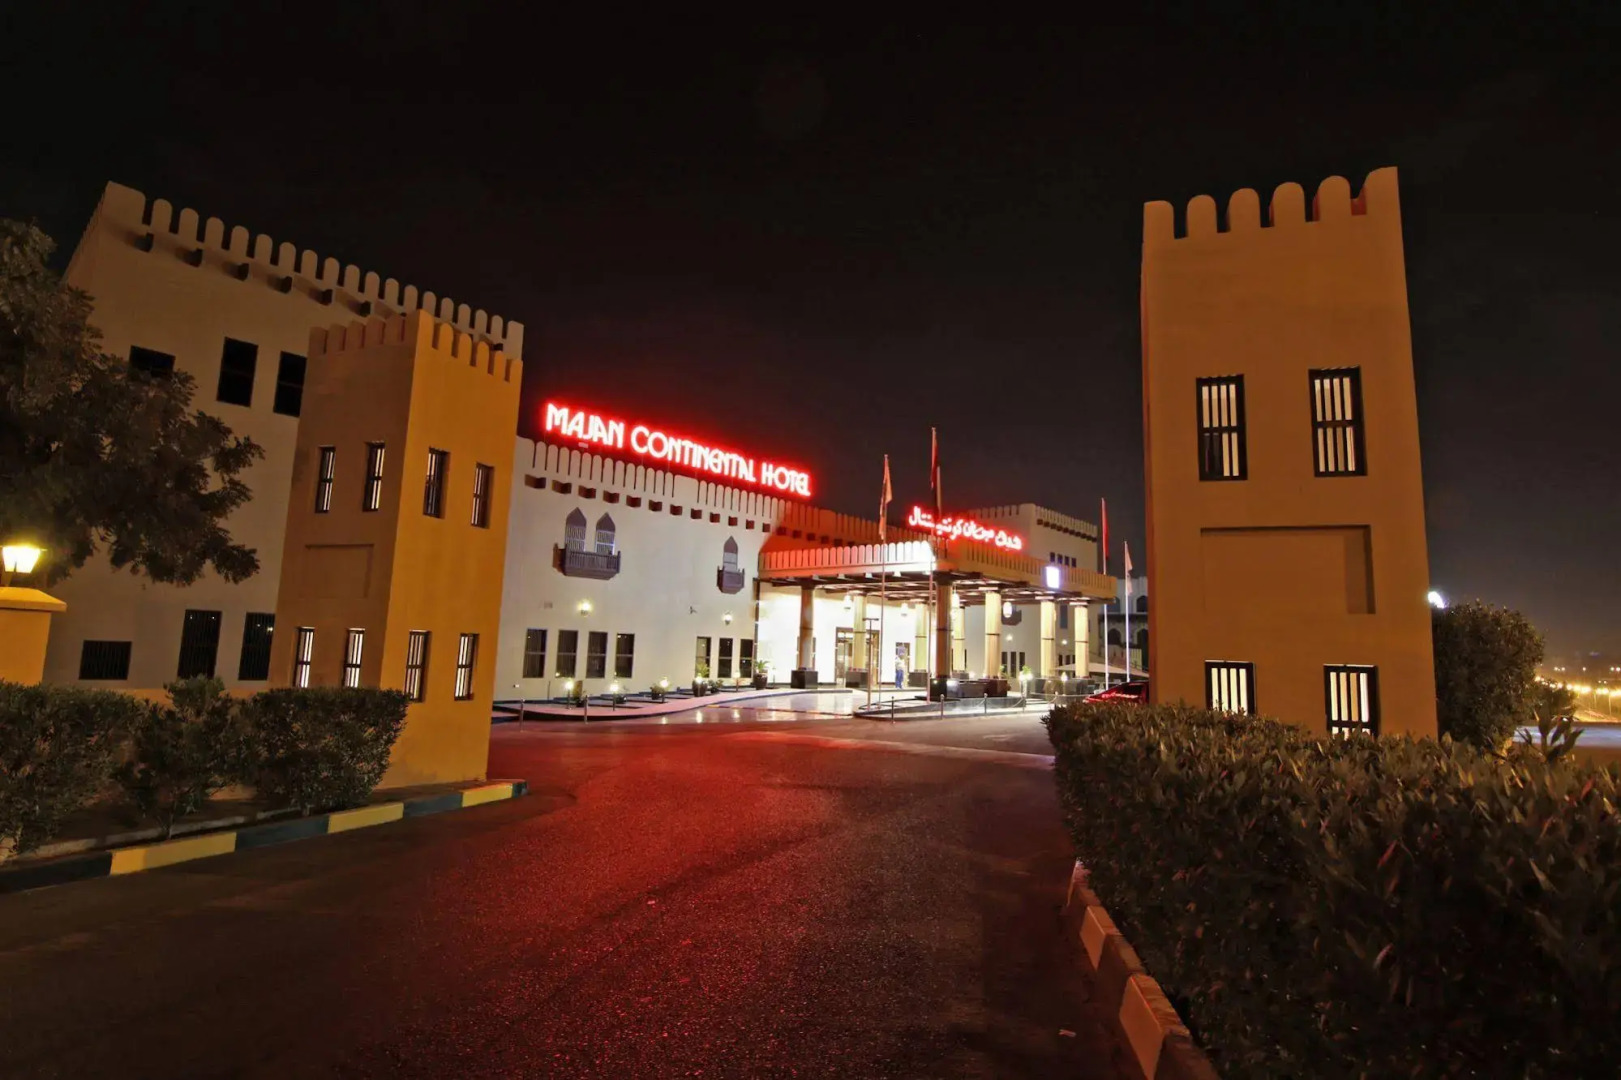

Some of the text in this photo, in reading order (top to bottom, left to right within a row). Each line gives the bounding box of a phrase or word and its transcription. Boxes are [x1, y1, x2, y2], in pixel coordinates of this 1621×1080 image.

[546, 403, 811, 496] MAJAN CONTINENTAL HOTEL
